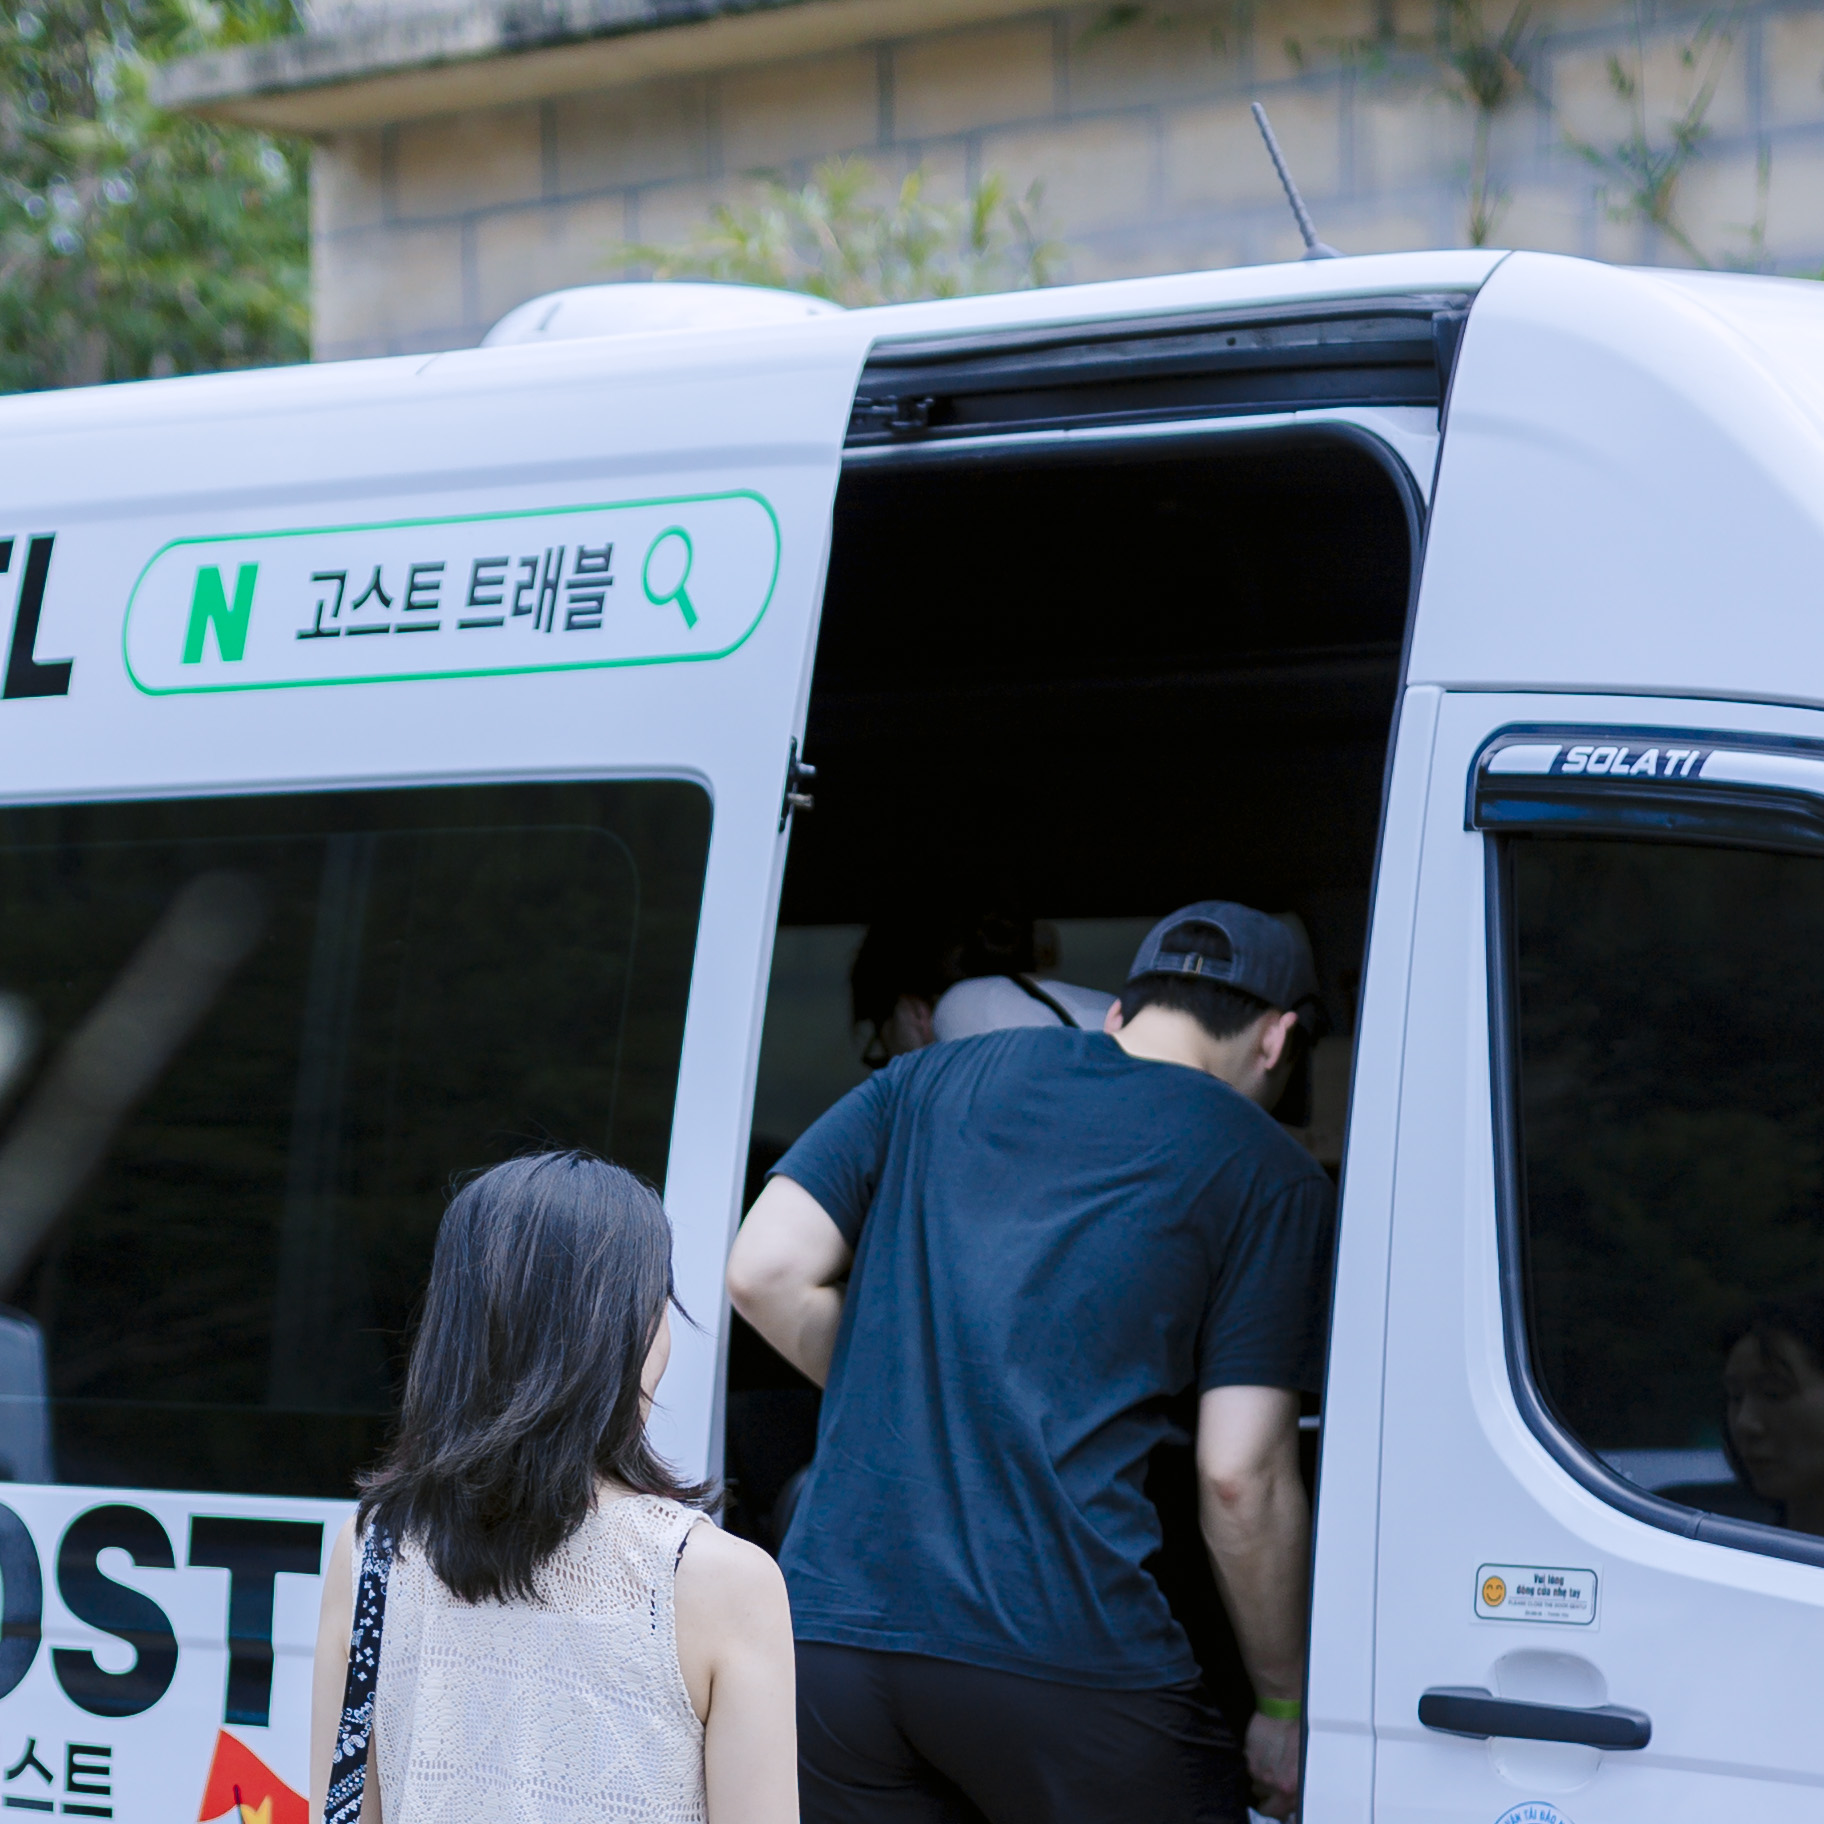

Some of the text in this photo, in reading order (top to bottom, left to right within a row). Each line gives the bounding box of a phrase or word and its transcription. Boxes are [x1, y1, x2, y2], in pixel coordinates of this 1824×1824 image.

[180, 561, 259, 664] N
[295, 542, 614, 640] 고스트 트래블
[1561, 745, 1701, 777] SOLATI
[1569, 1587, 1581, 1599] tay
